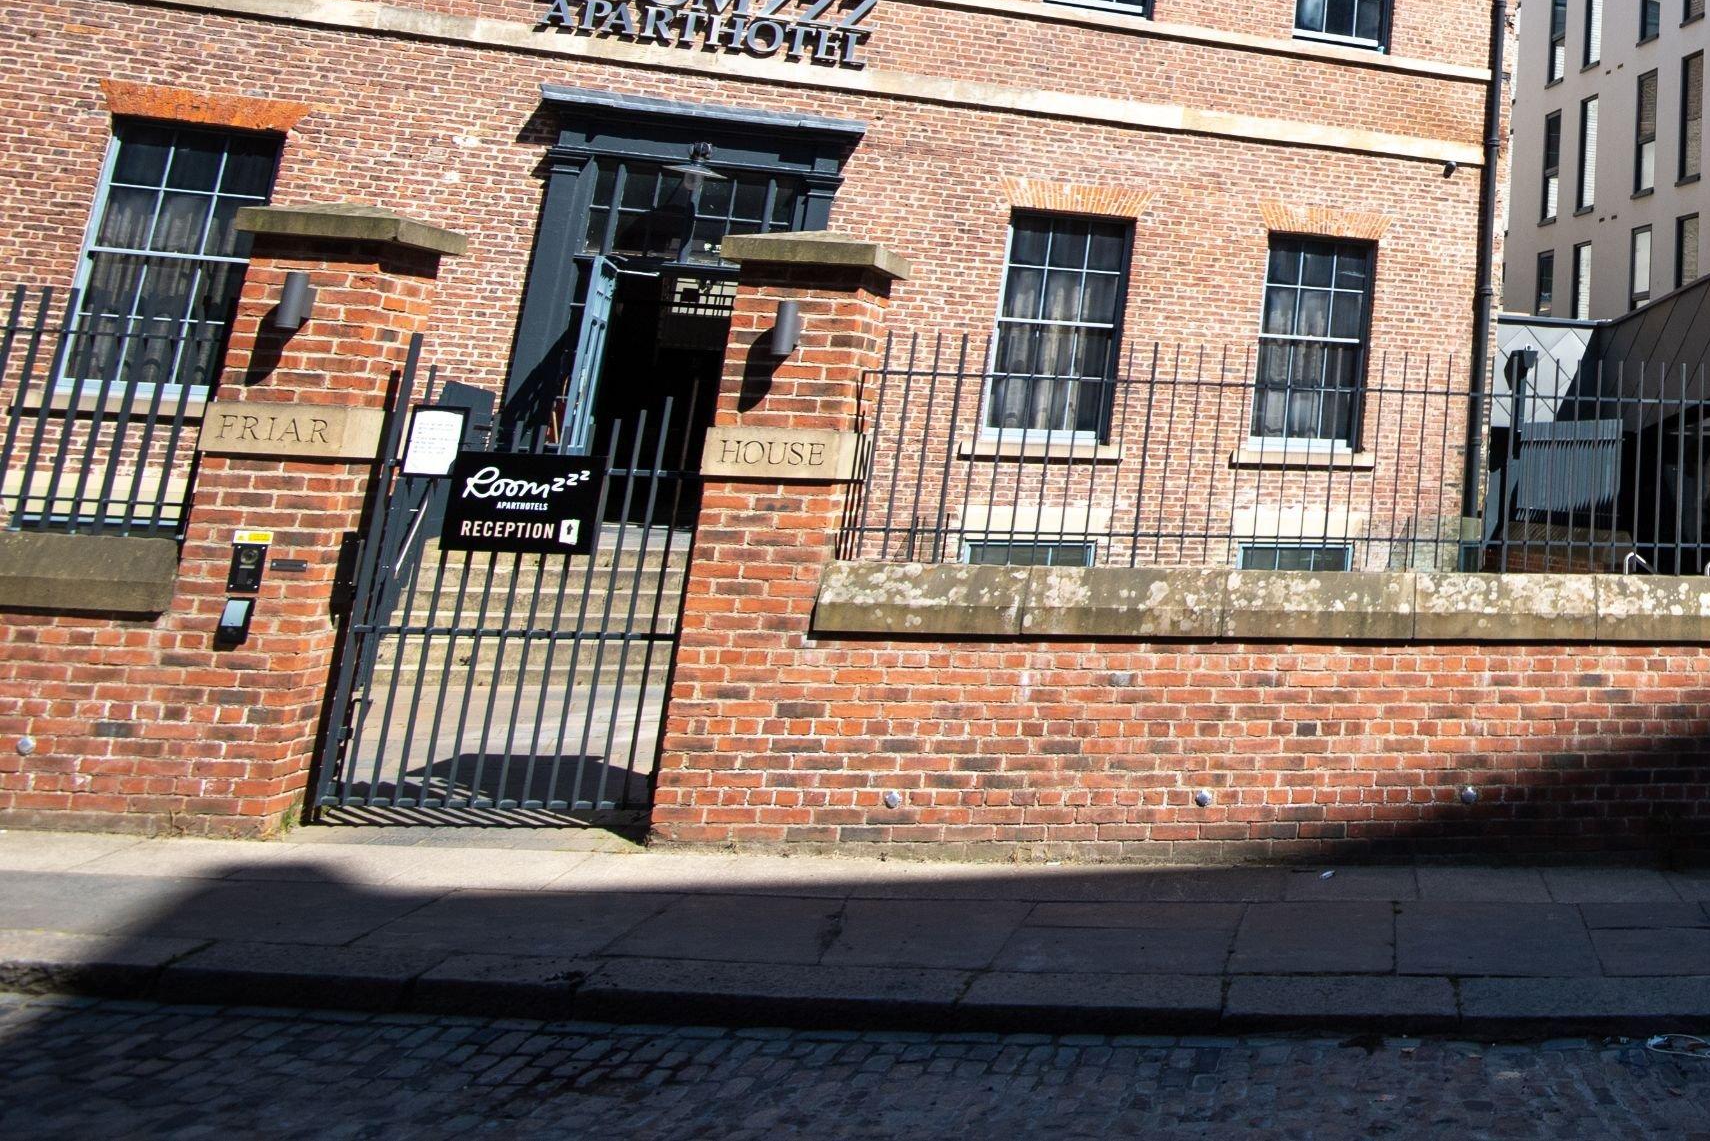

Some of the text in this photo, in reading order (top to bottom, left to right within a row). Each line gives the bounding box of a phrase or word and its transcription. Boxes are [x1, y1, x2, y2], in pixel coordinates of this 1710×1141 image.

[215, 414, 329, 444] FRIAR
[716, 439, 826, 466] HOUSE
[496, 501, 548, 511] APARTHOTELS
[460, 520, 555, 539] RECEPTION
